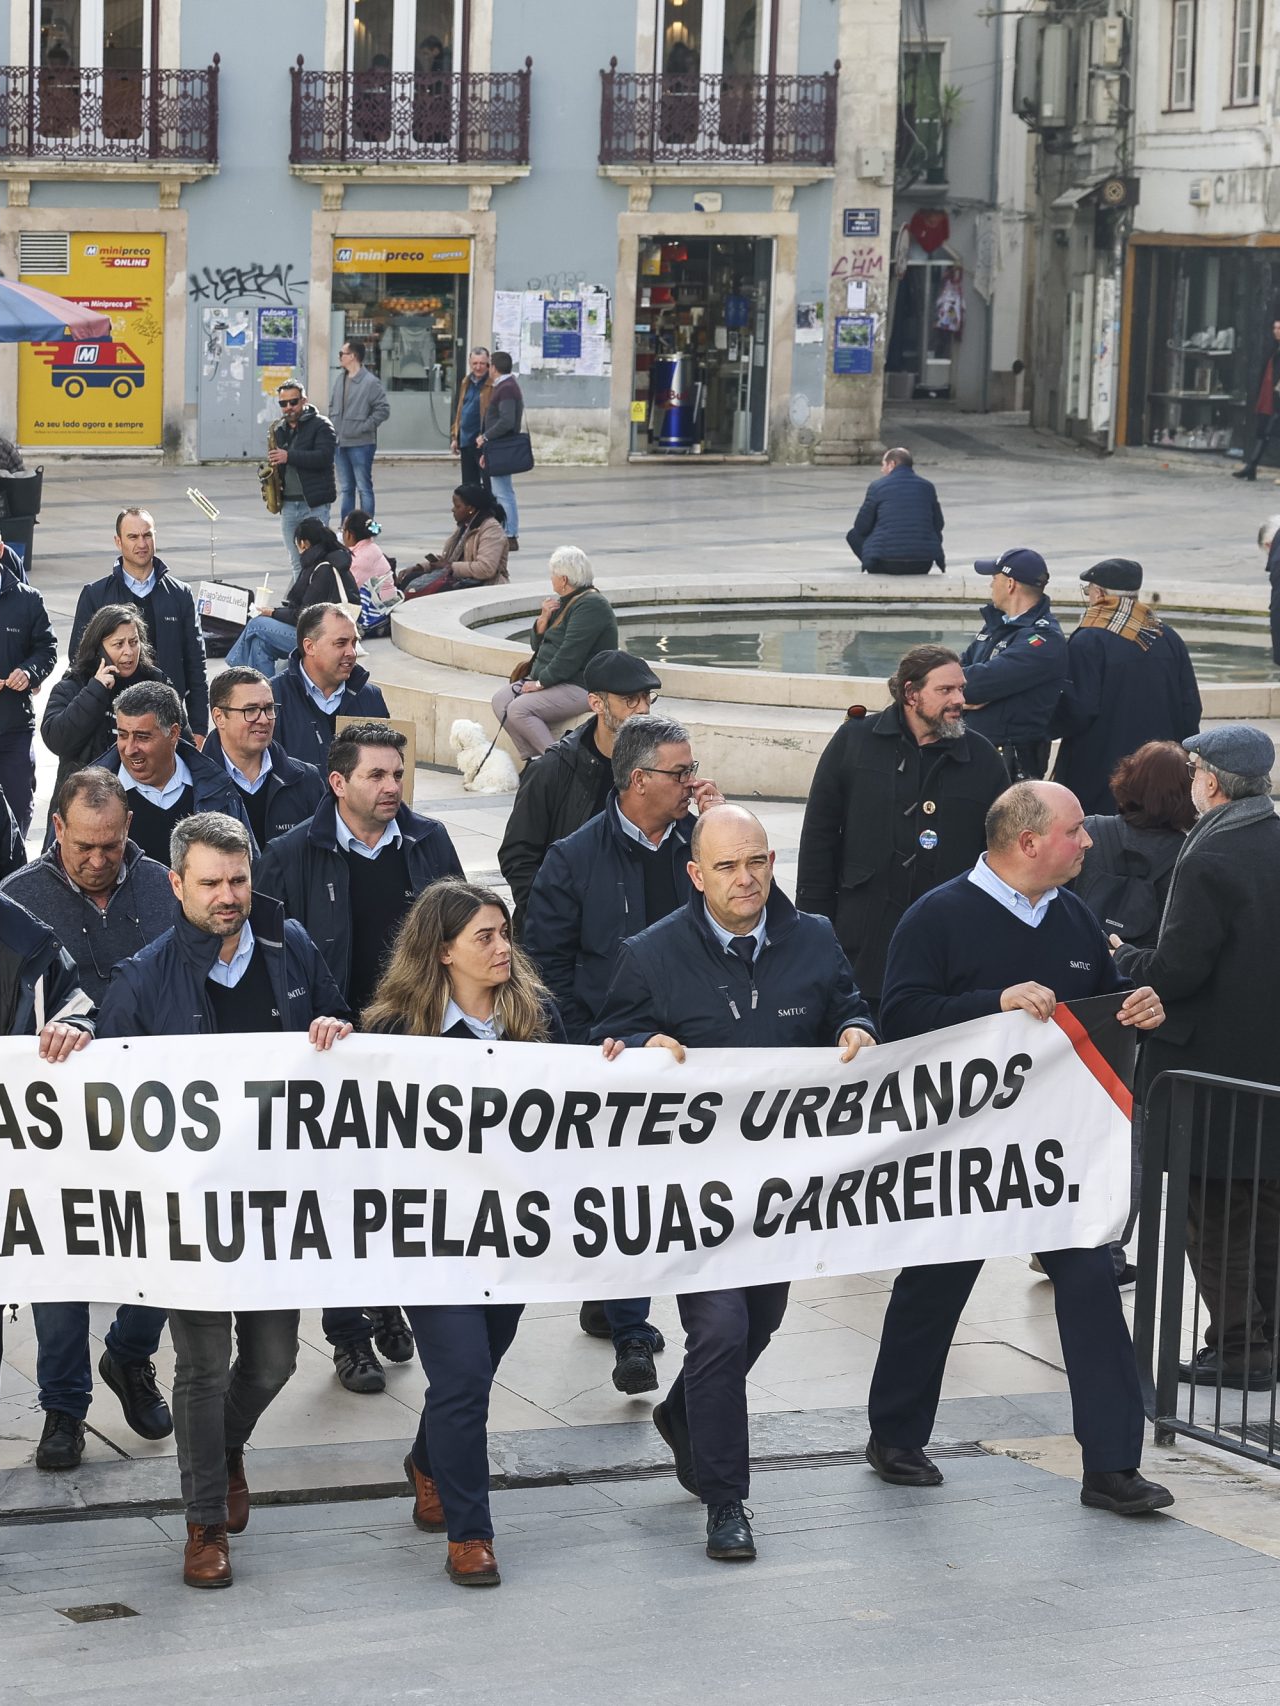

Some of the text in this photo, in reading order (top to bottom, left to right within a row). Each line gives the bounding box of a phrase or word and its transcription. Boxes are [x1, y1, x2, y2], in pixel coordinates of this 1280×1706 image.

[355, 248, 424, 262] minipreço
[114, 259, 148, 267] ONLINE
[34, 420, 44, 428] Ao
[63, 420, 80, 428] lado
[115, 422, 144, 430] sempre
[1070, 960, 1090, 970] SMTUC
[287, 987, 305, 999] SMTUC
[778, 1007, 807, 1017] SMTUC
[84, 1080, 221, 1152] DOS
[244, 1079, 724, 1153] TRANSPORTES
[739, 1052, 1033, 1142] URBANOS
[60, 1188, 147, 1259] EM
[166, 1189, 332, 1263] LUTA
[353, 1188, 552, 1259] PELAS
[572, 1180, 735, 1259] SUAS
[752, 1138, 1080, 1239] CARREIRAS.
